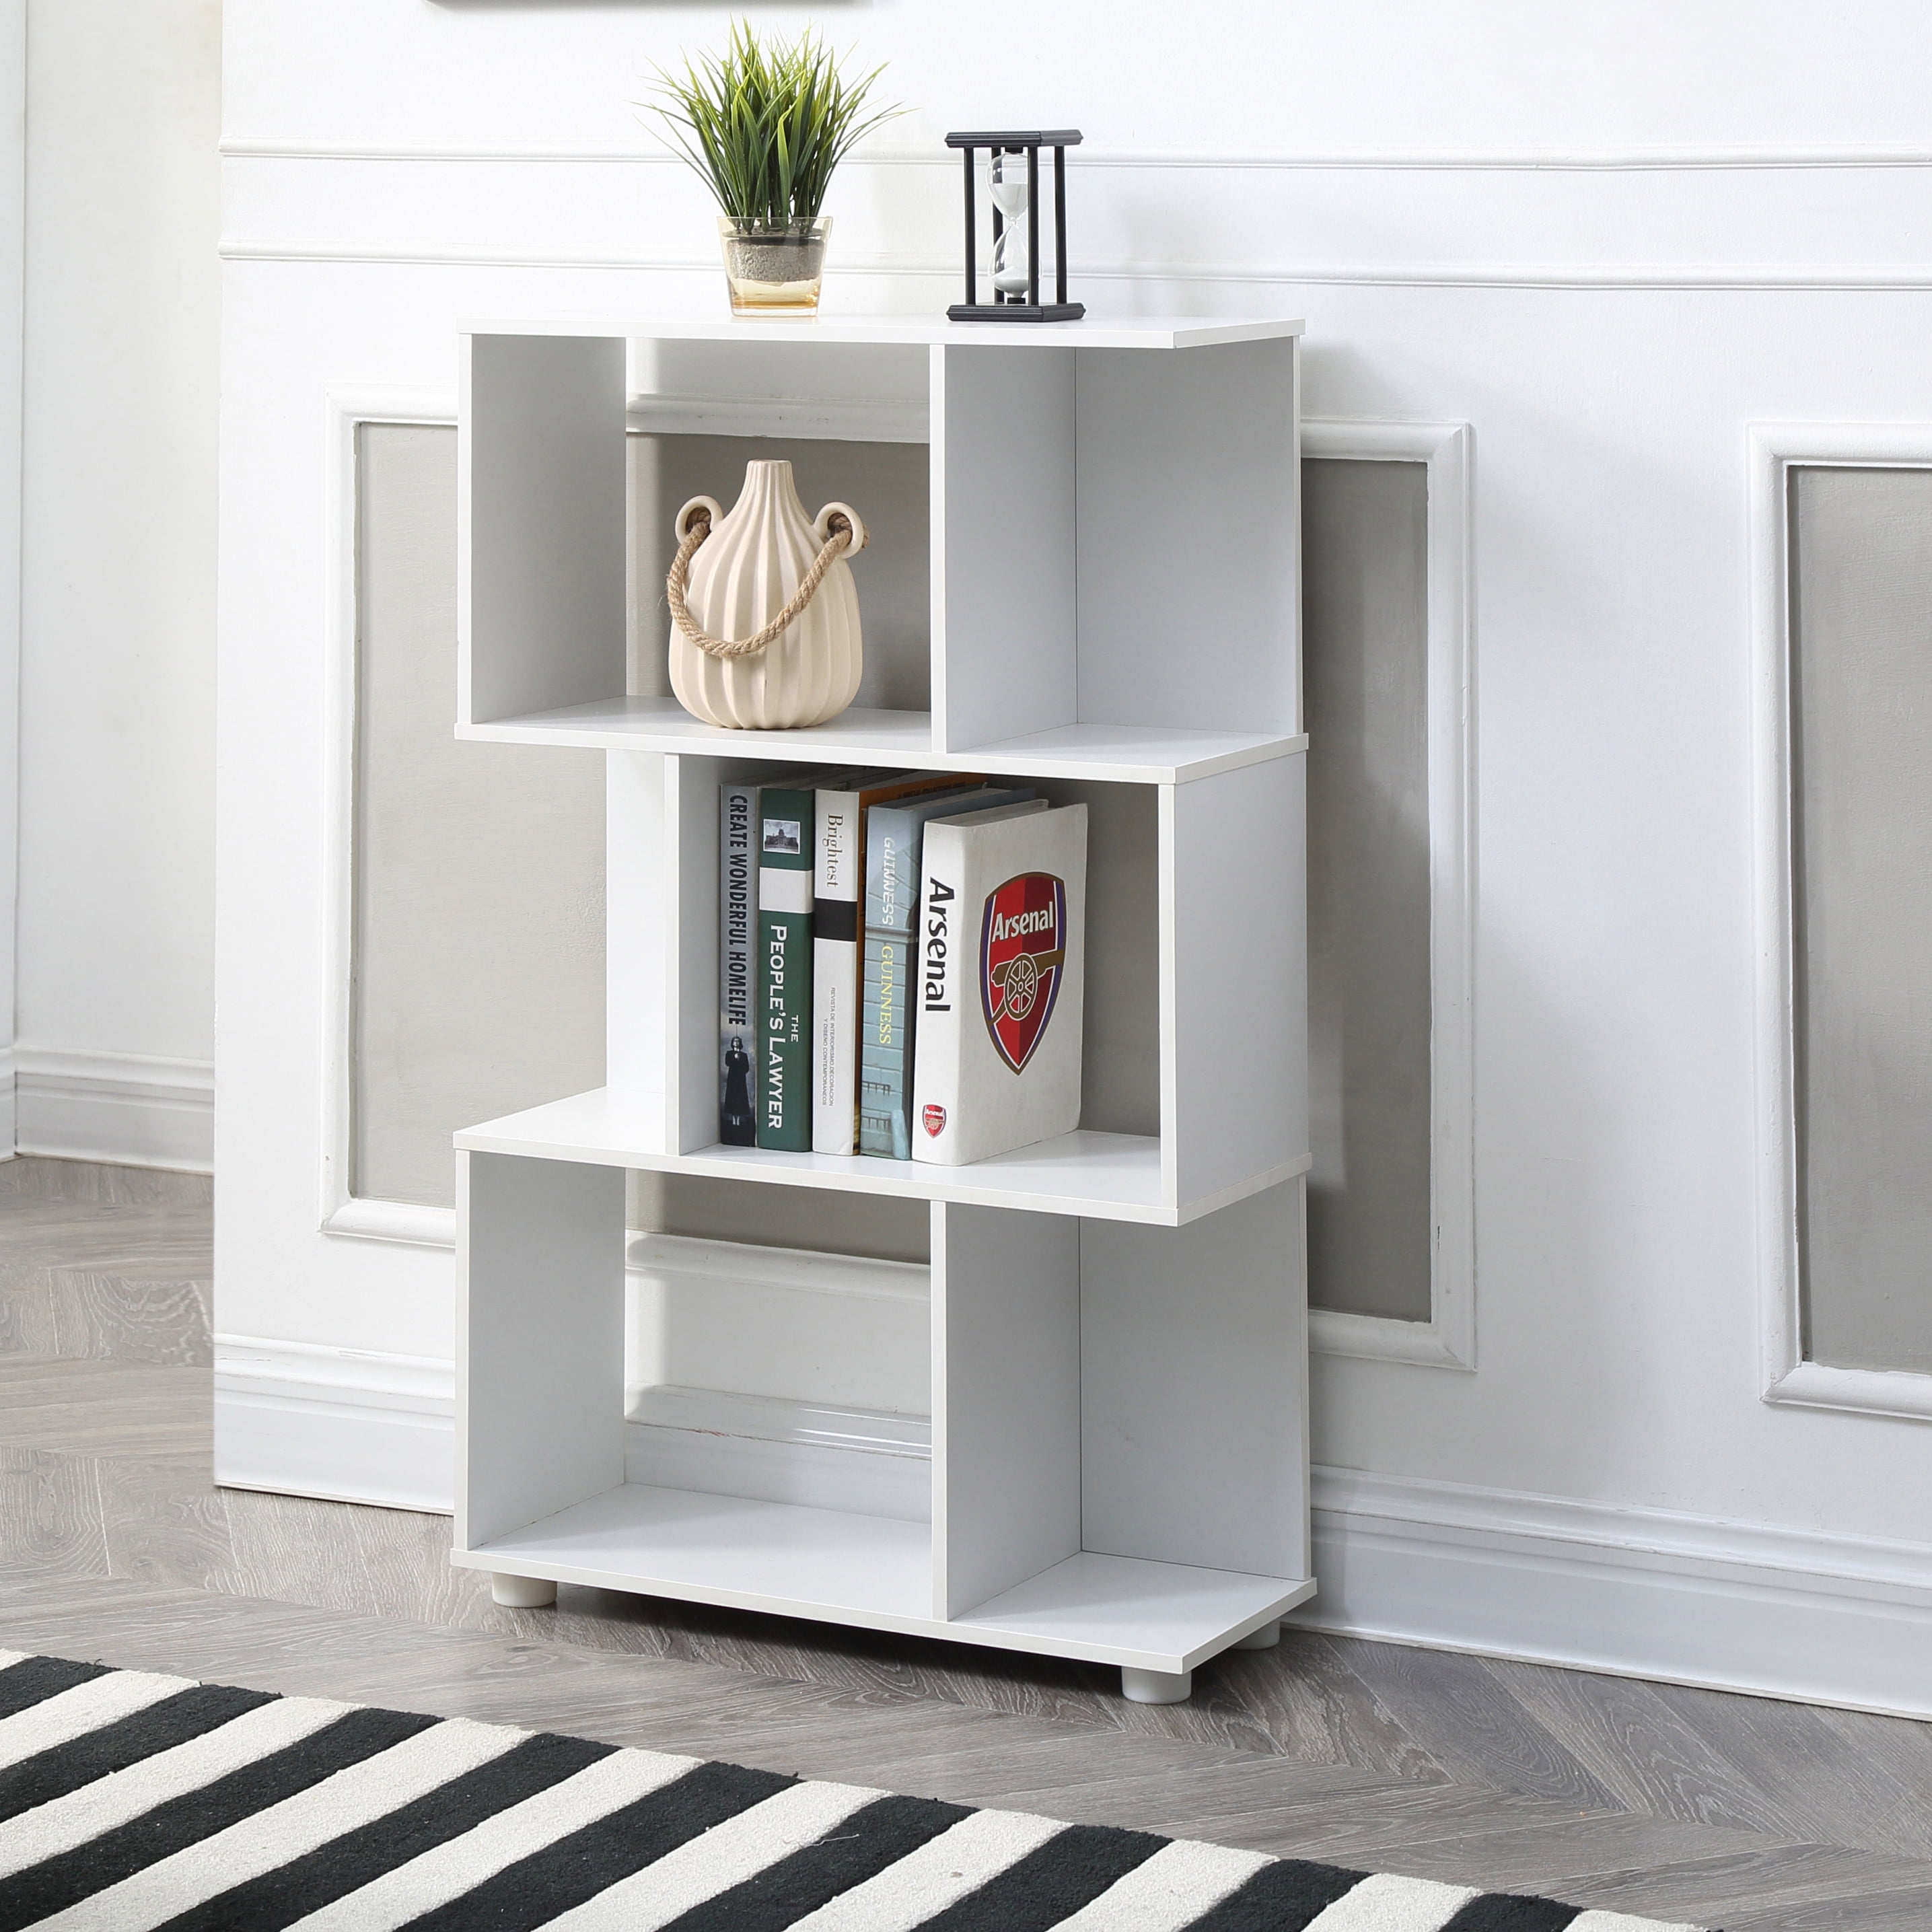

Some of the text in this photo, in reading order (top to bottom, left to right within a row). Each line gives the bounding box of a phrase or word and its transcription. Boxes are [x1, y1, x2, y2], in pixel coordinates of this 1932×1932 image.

[822, 814, 843, 888] Brightest
[882, 836, 896, 927] GUINNESS
[728, 795, 748, 1026] CREATE WONDERFUL HOMELIFE
[925, 877, 955, 1012] Arsenal
[991, 901, 1054, 943] Arsenal
[768, 925, 787, 1129] PEOPLE'S LAWYER
[791, 1015, 799, 1042] THE
[830, 1013, 835, 1022] DE
[879, 945, 894, 1044] GUINNESS
